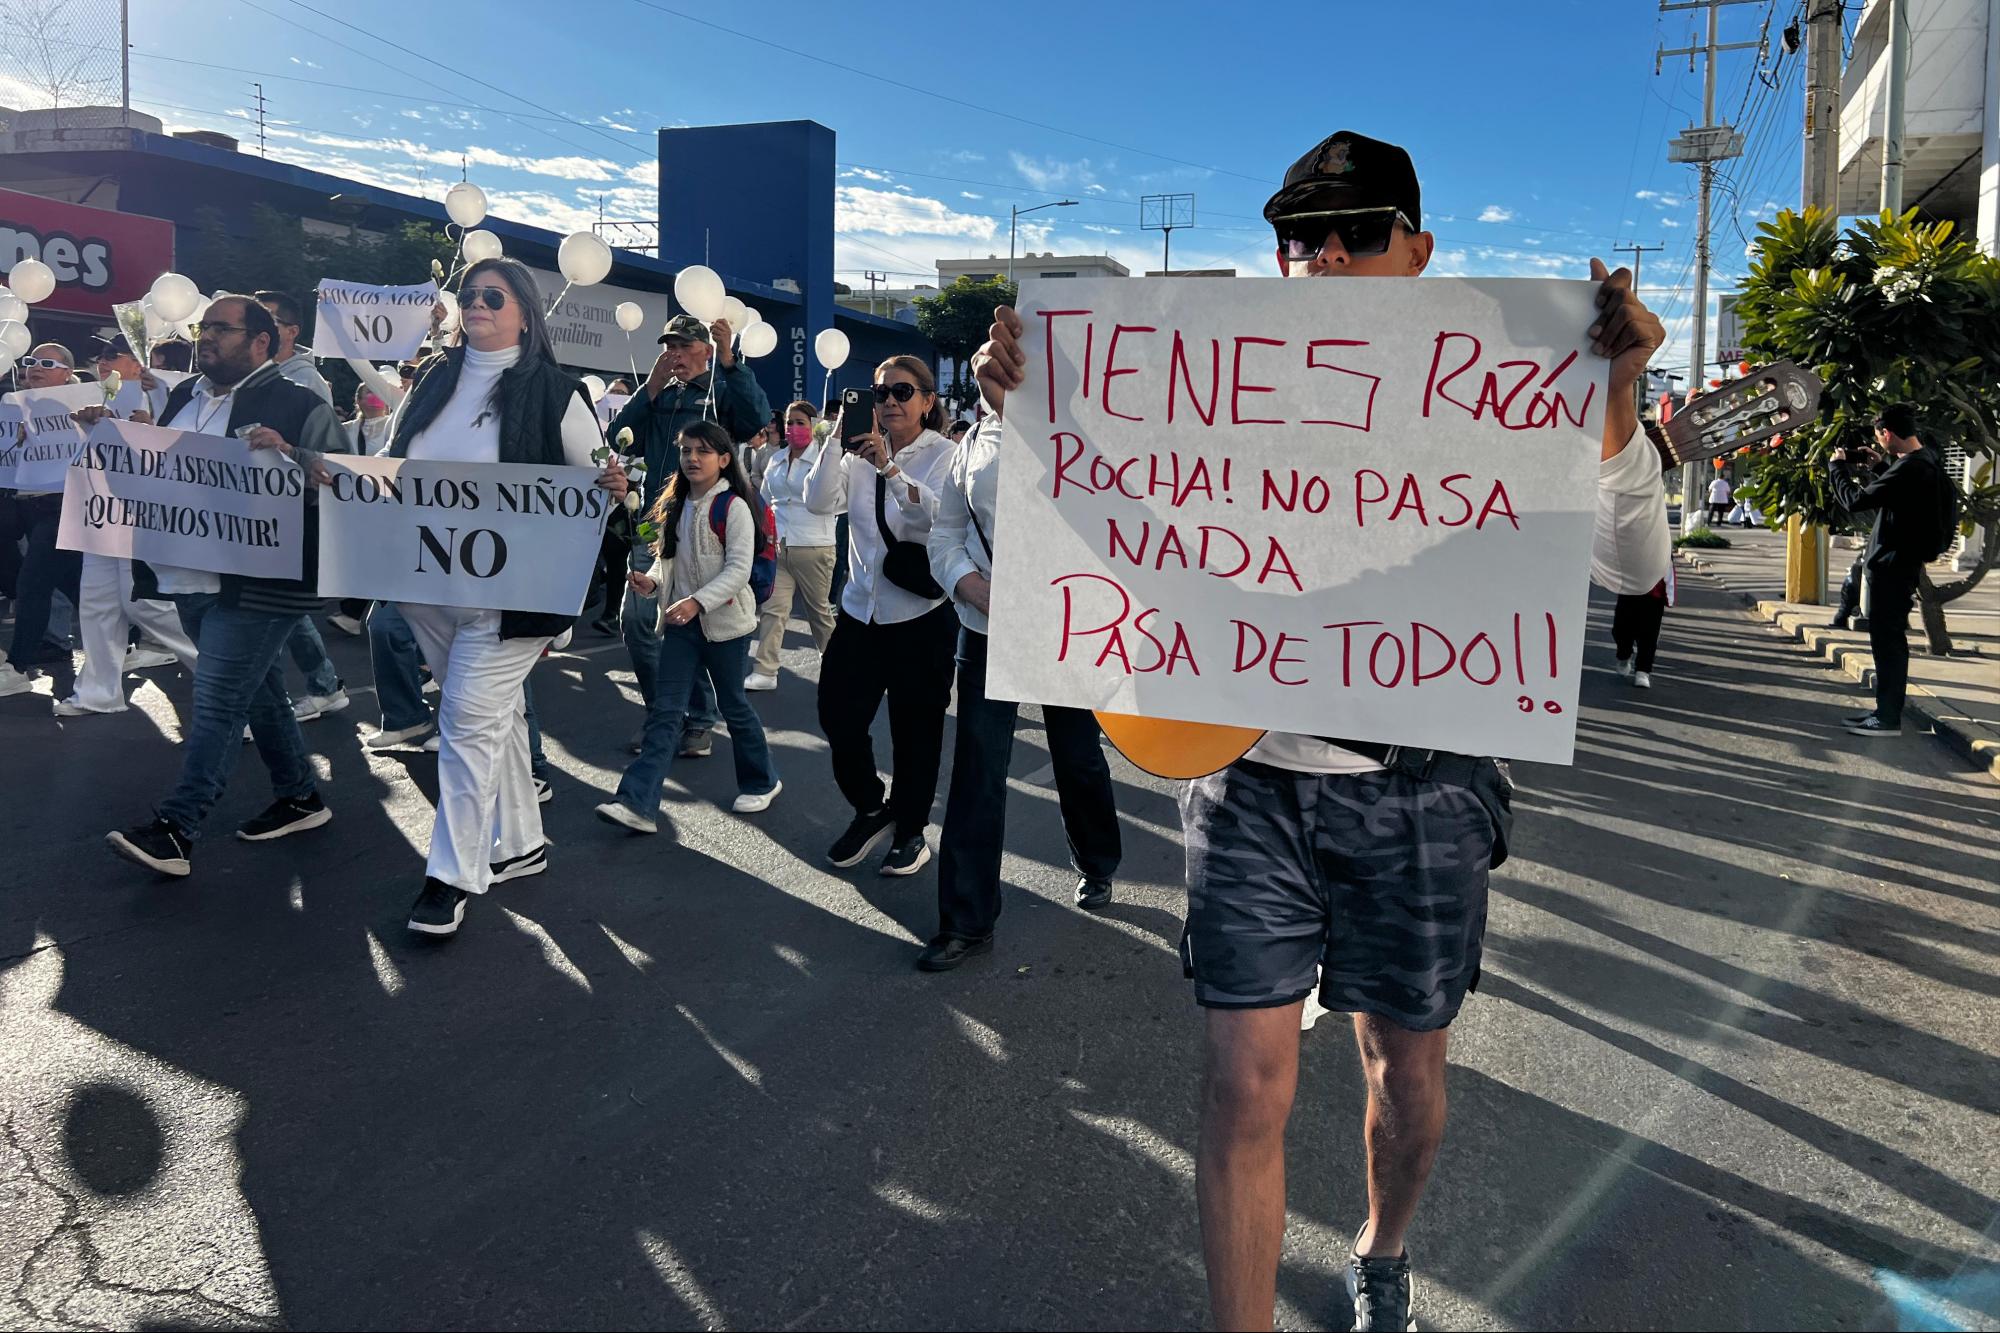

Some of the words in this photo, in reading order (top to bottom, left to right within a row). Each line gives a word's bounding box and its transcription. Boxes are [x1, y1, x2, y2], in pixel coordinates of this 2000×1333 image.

[323, 287, 350, 305] CON
[351, 289, 383, 305] LOS
[386, 290, 437, 306] NIÑOS
[583, 304, 617, 325] armo
[353, 314, 393, 343] NO
[547, 322, 603, 348] quilibra
[791, 327, 806, 339] LA
[792, 340, 804, 401] COLCH
[1036, 310, 1381, 432] TIENES
[1422, 331, 1595, 430] RAZÓN
[1719, 350, 1743, 361] ME
[34, 413, 75, 437] JUSTIC
[23, 444, 54, 463] GAEL
[140, 449, 167, 479] DE
[168, 454, 302, 498] ASESINATOS
[331, 472, 403, 505] CON
[412, 477, 480, 511] LOS
[496, 477, 603, 520] NIÑOS
[1049, 432, 1233, 508] ROCHA!
[1262, 469, 1330, 514] NO
[1354, 469, 1520, 531] PASA
[84, 494, 209, 538] ¡QUEREMOS
[213, 511, 280, 548] VIVIR!
[414, 525, 508, 579] NO
[1107, 518, 1303, 592] NADA
[1050, 573, 1200, 677] PASA
[1229, 619, 1309, 686] DE
